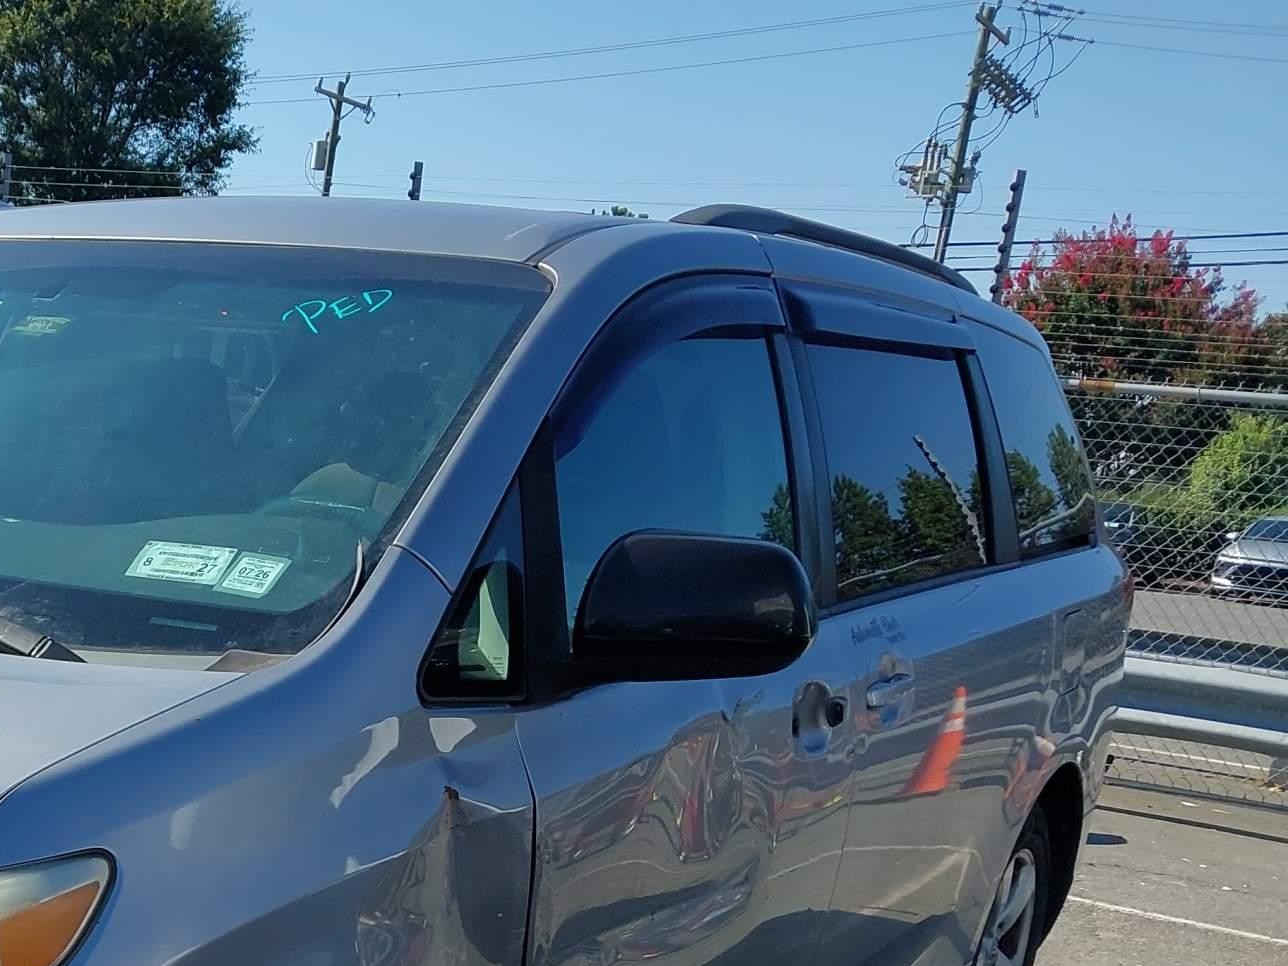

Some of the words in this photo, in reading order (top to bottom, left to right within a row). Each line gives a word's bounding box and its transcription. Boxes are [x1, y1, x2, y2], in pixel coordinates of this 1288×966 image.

[281, 289, 393, 334] PED
[143, 557, 154, 567] 8
[197, 563, 218, 574] 27
